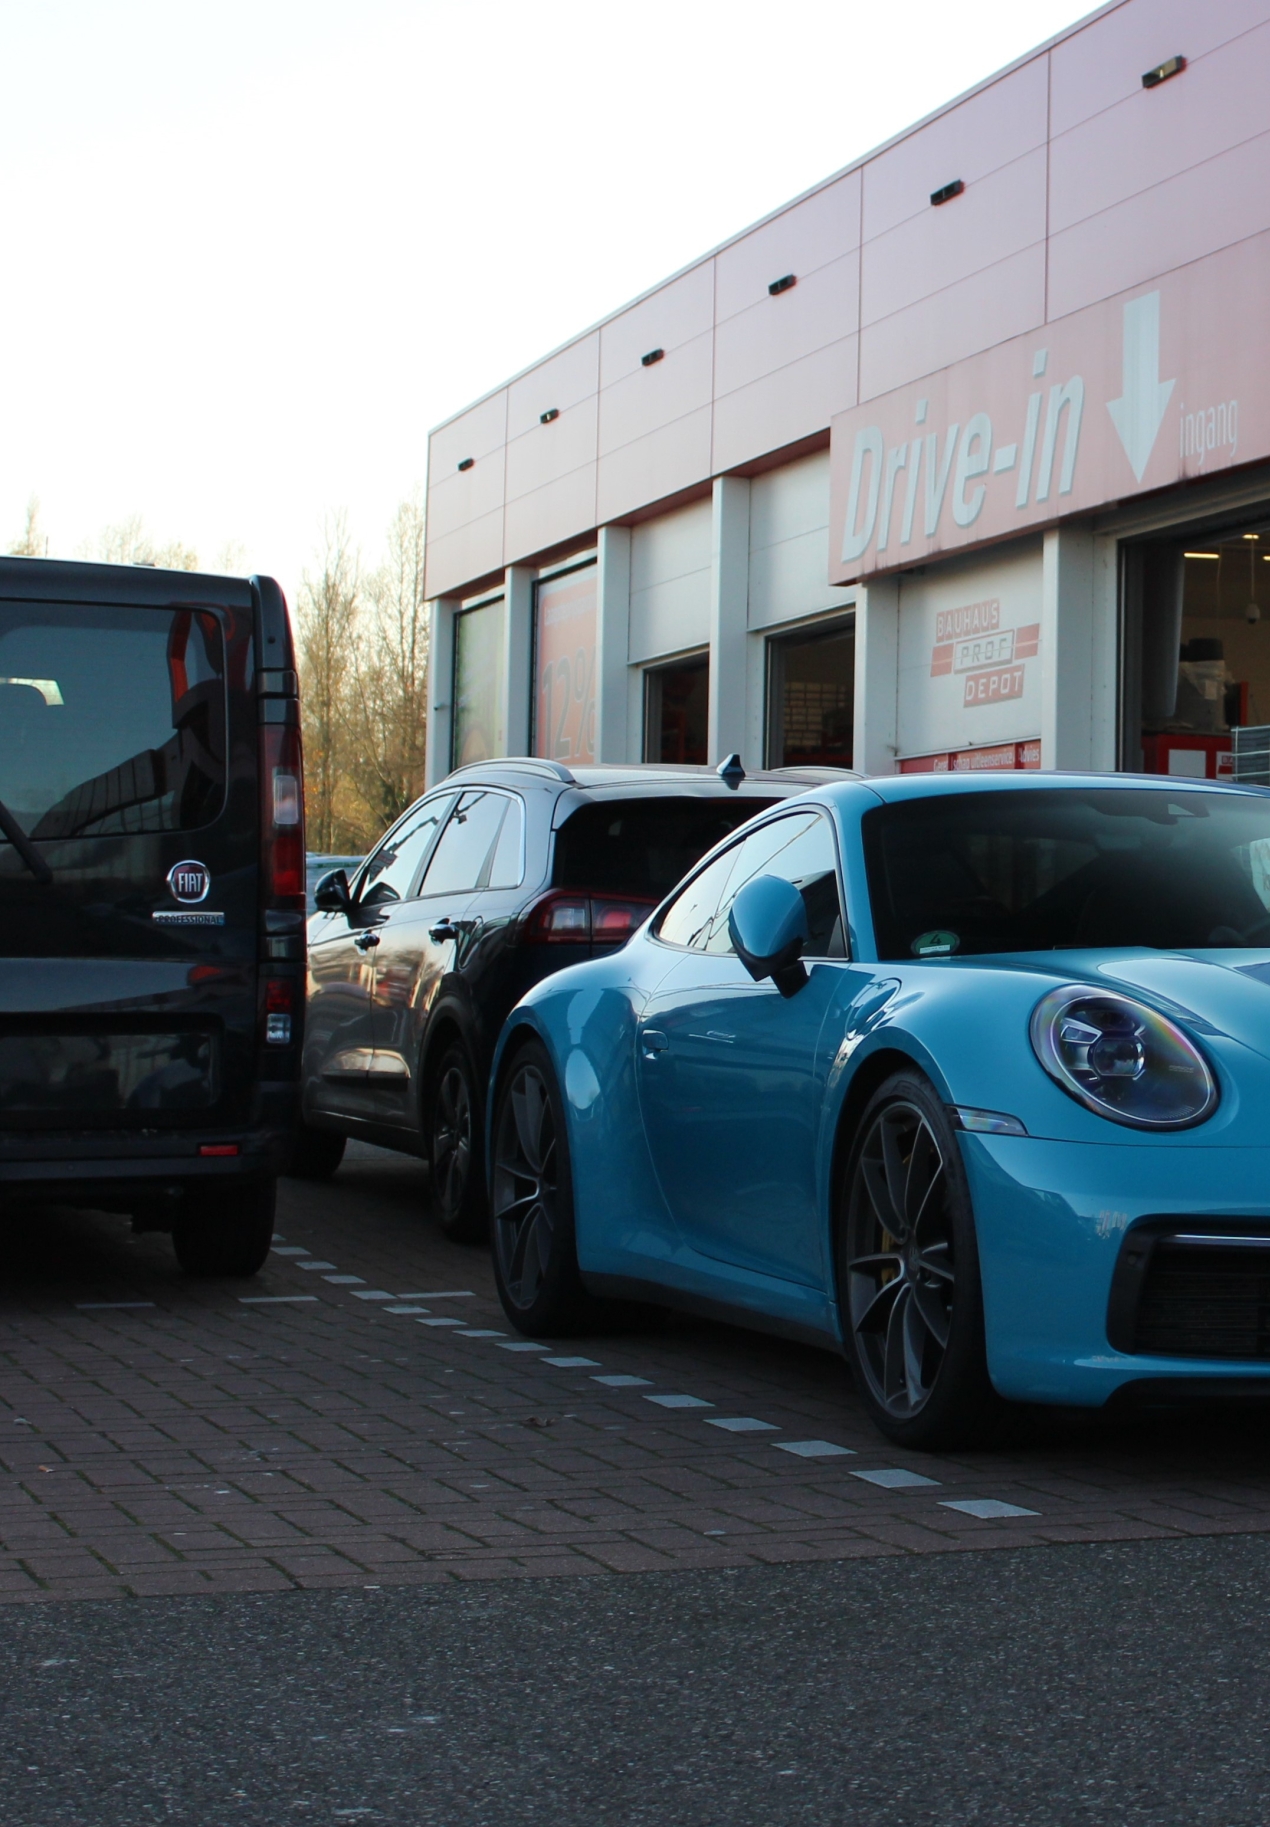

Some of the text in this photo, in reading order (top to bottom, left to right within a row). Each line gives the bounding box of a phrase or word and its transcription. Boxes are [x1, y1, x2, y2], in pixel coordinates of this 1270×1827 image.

[1179, 397, 1239, 467] ingang
[840, 348, 1085, 564] Drive-in
[937, 603, 999, 637] BAUHAUS
[960, 638, 1008, 665] PROF
[965, 671, 1022, 701] DEPOT
[178, 872, 203, 893] FIAT
[158, 915, 221, 925] PROFESSIONAL
[929, 934, 942, 945] 4
